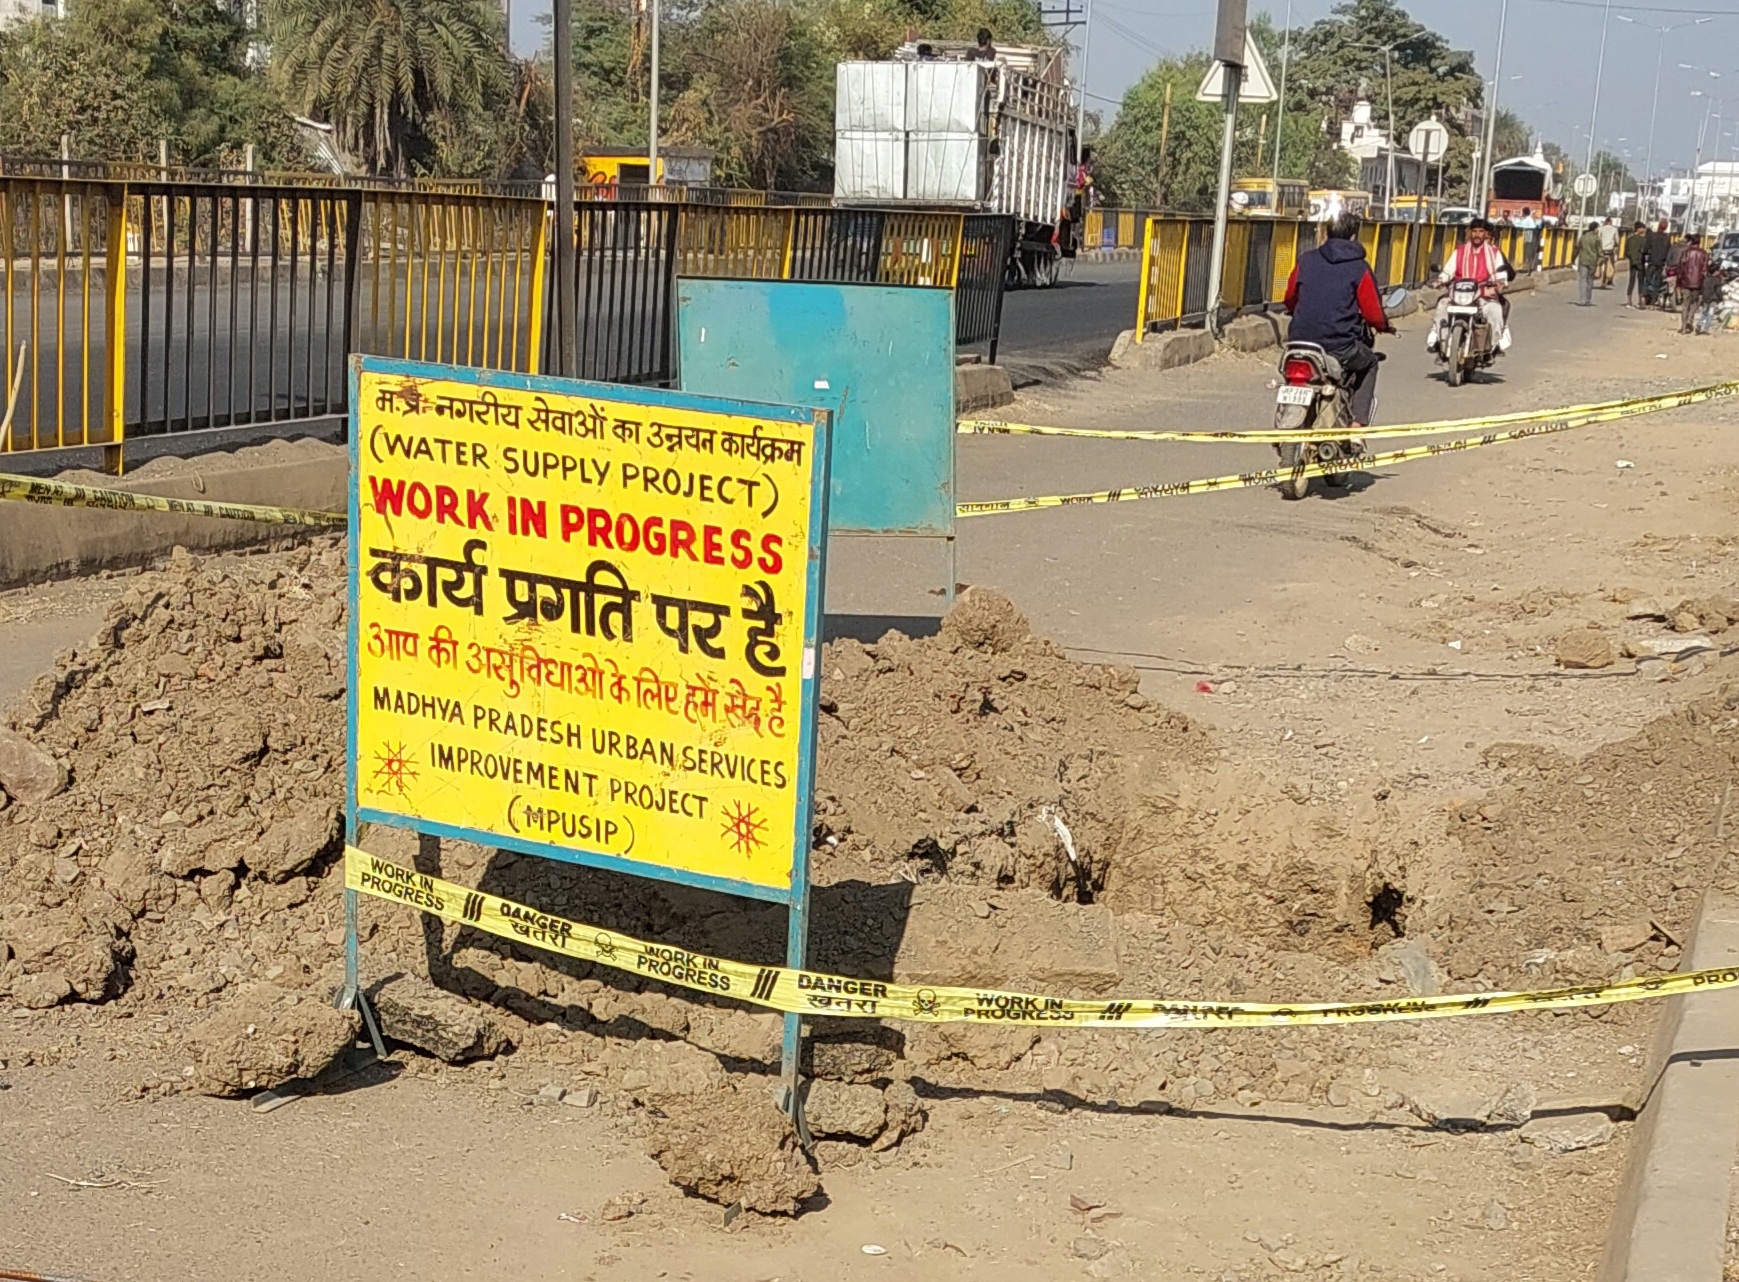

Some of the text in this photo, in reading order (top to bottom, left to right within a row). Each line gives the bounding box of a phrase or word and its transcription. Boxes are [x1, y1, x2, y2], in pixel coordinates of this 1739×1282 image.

[435, 391, 523, 430] नगरीय
[526, 396, 608, 440] सेवाओं
[612, 418, 643, 444] का
[647, 421, 718, 456] उन्नयन
[721, 425, 806, 467] कार्यक्रम
[370, 424, 780, 519] (WATER SUPPLY PROJECT)
[369, 475, 783, 575] WORK IN PROGRESS
[369, 539, 787, 677] कार्य प्रगति पर है
[367, 621, 420, 662] आप
[427, 624, 459, 670] की
[604, 658, 631, 705] के
[632, 666, 679, 716] लिए
[765, 681, 788, 738] है
[373, 686, 788, 789] MADHYA PRADESH URBAN SERVICES
[430, 742, 709, 820] IMPROVEMENT PROJECT
[507, 794, 635, 855] (MPUSIP)
[360, 872, 445, 912] PROGRESS
[370, 857, 434, 893] WORK IN
[500, 902, 573, 937] DANGER
[508, 919, 568, 949] खतरा
[636, 954, 731, 991] PROGRESS
[643, 944, 719, 971] WORK IN
[798, 973, 888, 999] DANGER
[805, 993, 880, 1014] खतरा
[976, 992, 1064, 1011] WORK IN
